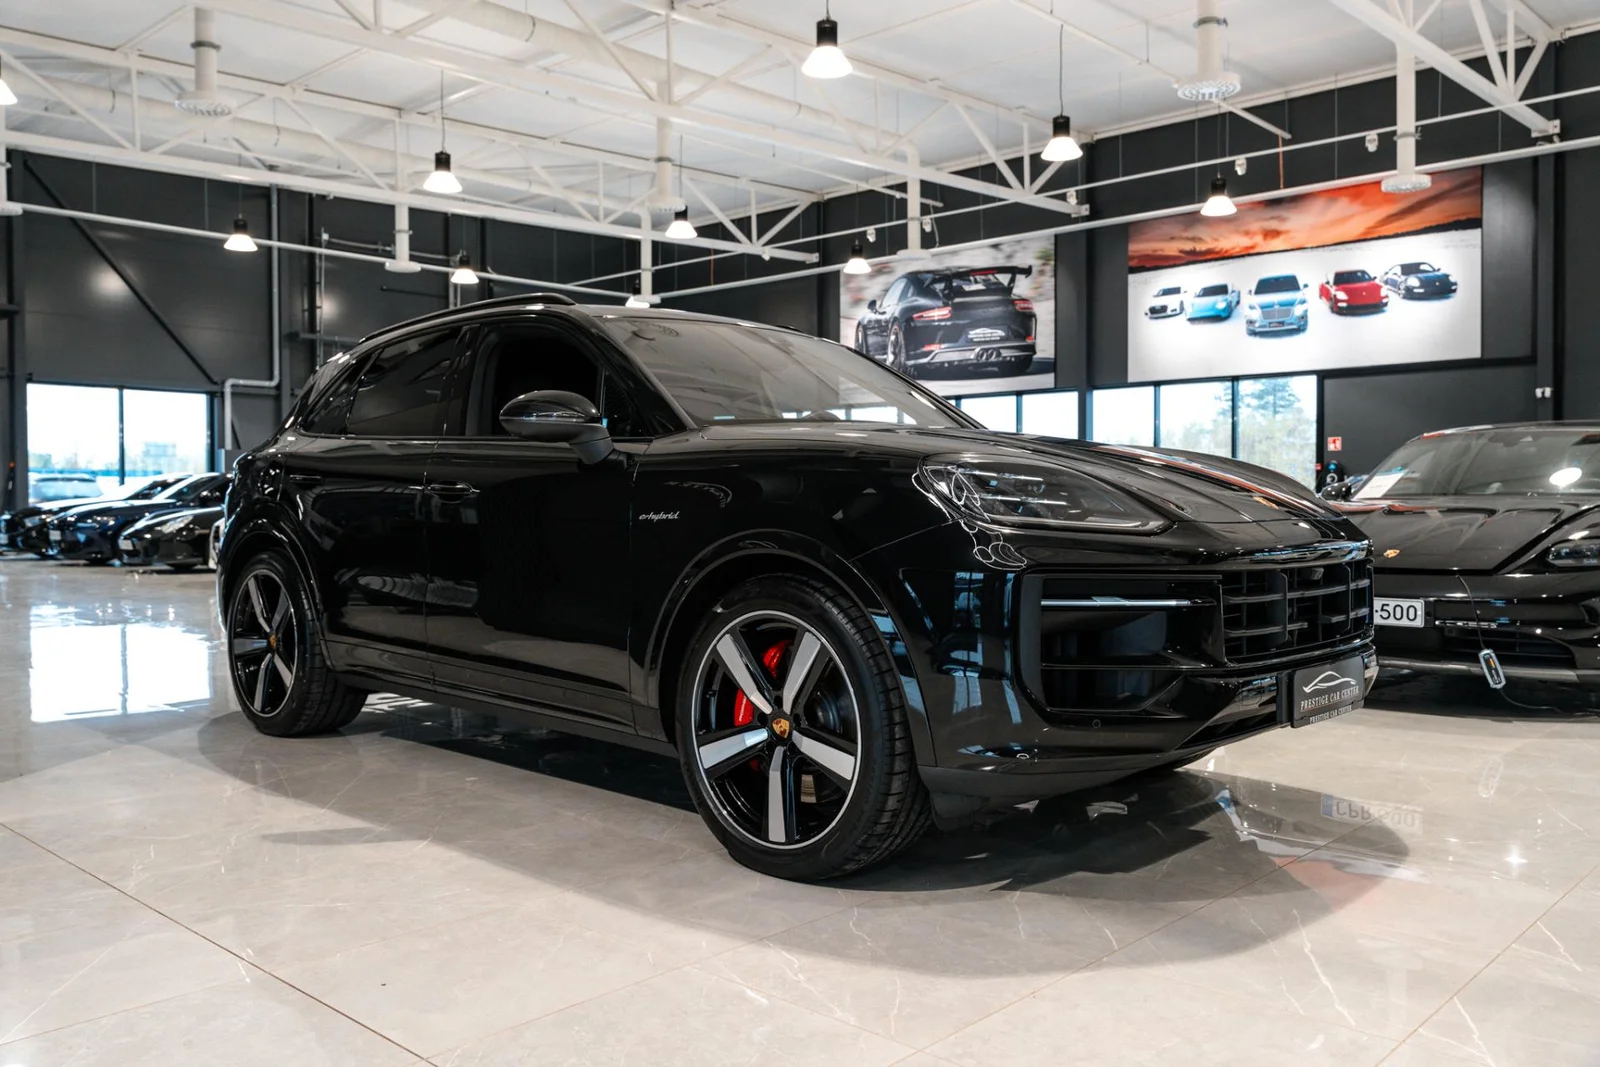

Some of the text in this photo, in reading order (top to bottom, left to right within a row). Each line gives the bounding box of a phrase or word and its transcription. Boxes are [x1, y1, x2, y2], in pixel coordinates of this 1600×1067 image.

[1300, 685, 1360, 711] PRESTIGE CAR CENTER
